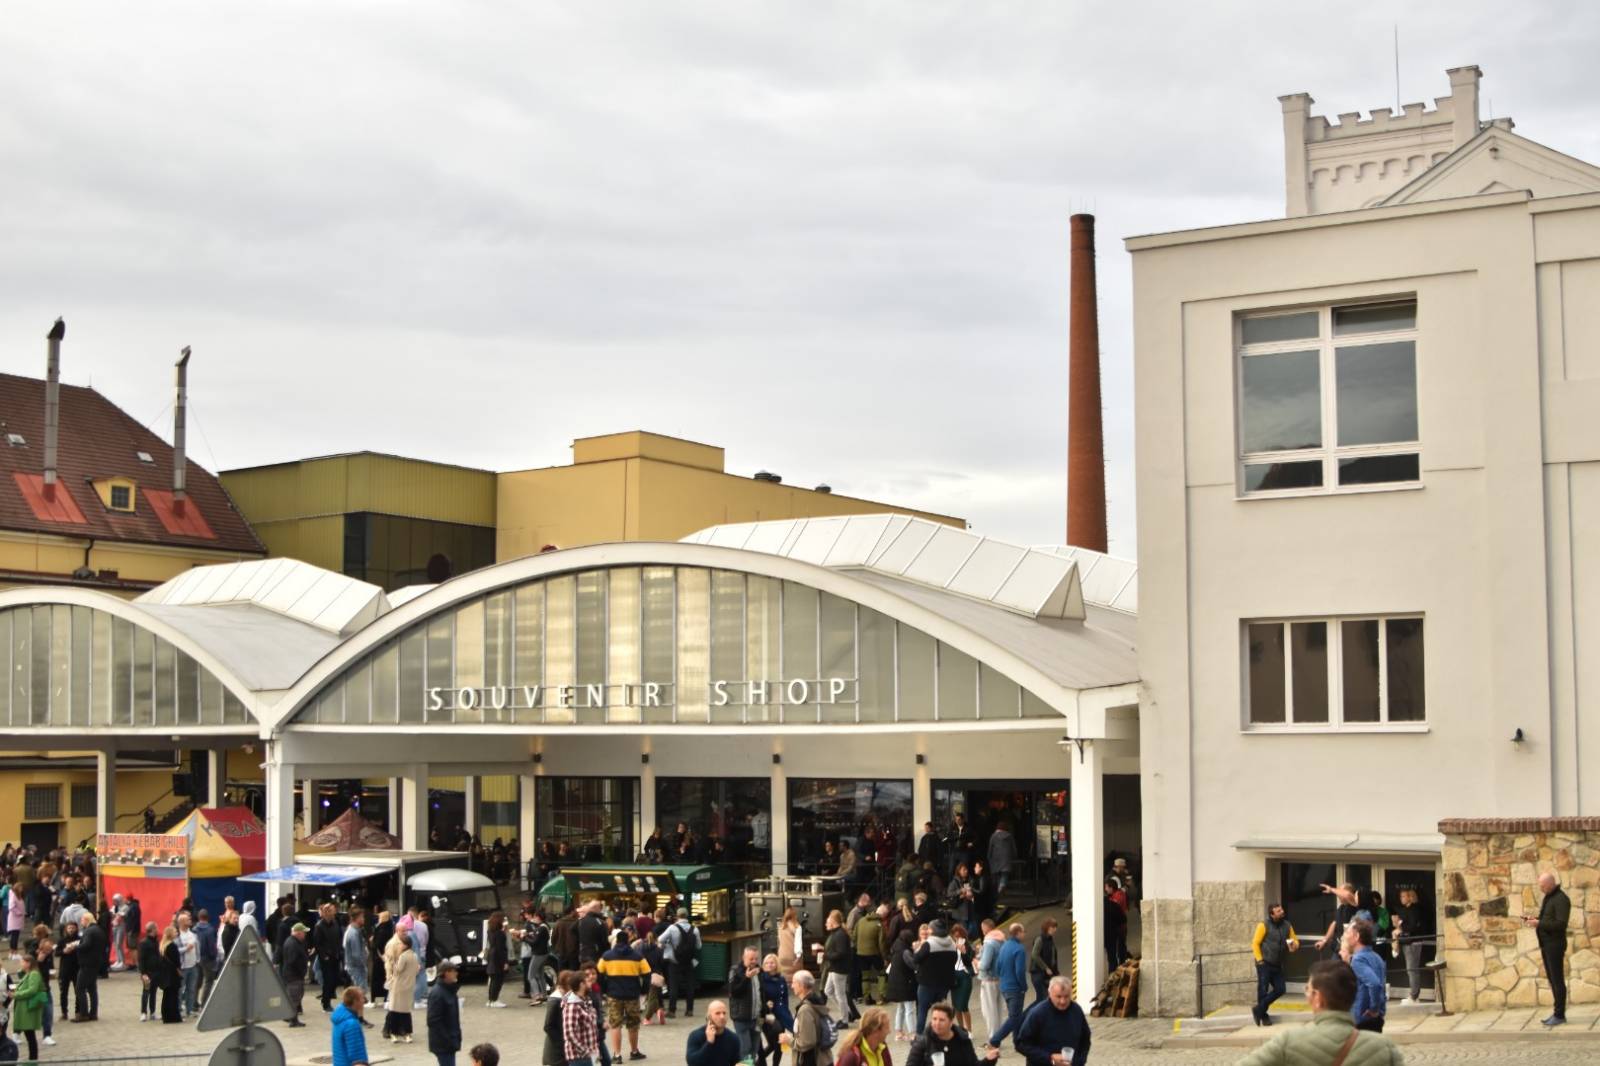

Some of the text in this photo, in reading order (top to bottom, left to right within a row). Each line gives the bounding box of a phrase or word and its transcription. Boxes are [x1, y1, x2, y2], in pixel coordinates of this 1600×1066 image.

[429, 678, 846, 710] SOUVENIR SHOP
[134, 835, 160, 848] KEBAB
[163, 836, 186, 849] GRILL
